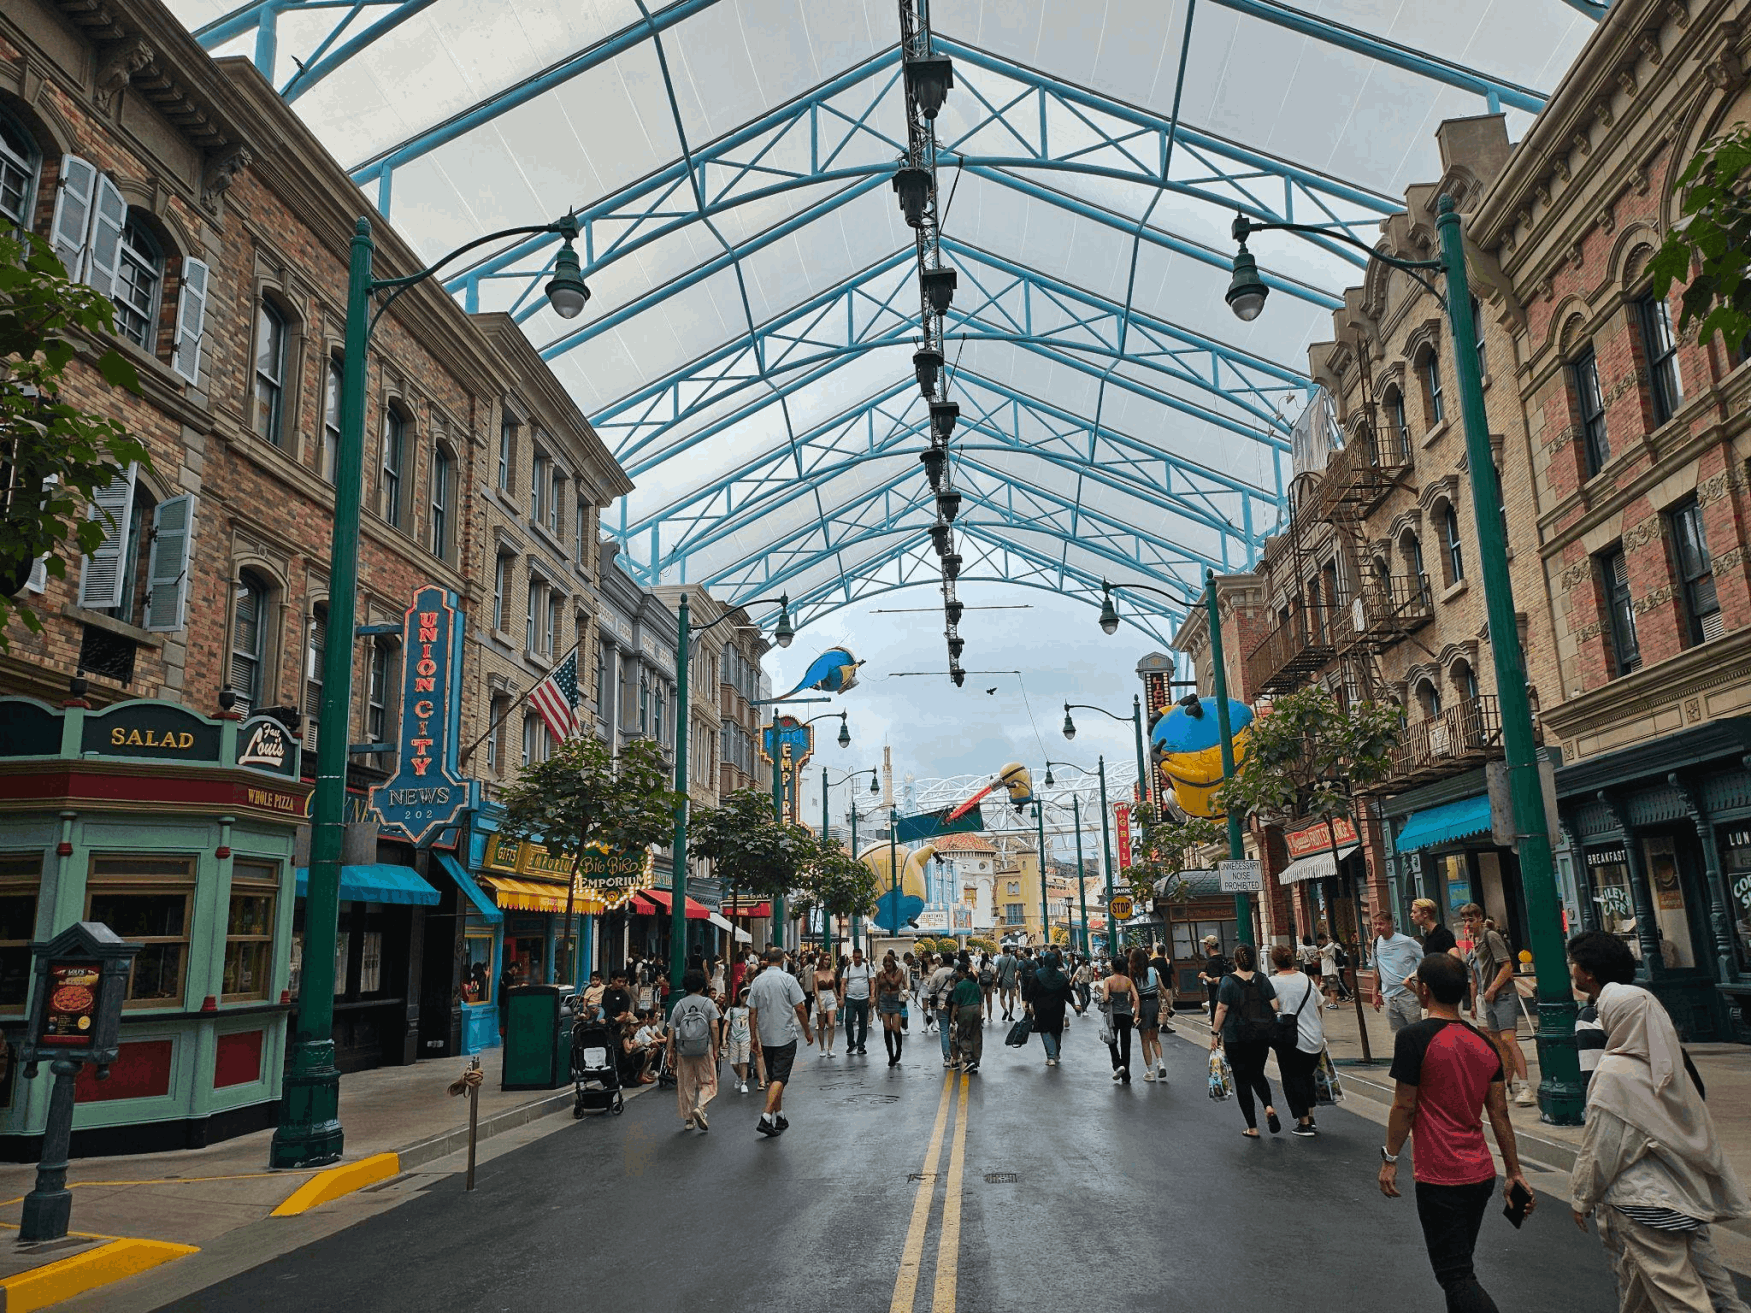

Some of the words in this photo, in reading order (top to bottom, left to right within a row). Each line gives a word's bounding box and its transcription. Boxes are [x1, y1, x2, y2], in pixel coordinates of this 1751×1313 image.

[416, 612, 438, 692] UNION
[111, 727, 194, 749] SALAD
[411, 700, 433, 776] CITY
[780, 743, 793, 829] EMPIRE
[247, 788, 273, 807] WHOLE
[274, 793, 294, 811] PIZZA
[388, 787, 450, 806] NEWS
[404, 810, 433, 819] 202
[1118, 819, 1129, 867] GRIL
[497, 846, 517, 863] GIFTS
[528, 852, 575, 874] EMPORIU
[1587, 850, 1626, 865] BREAKFAST
[1220, 861, 1260, 870] UNNECESSARY
[578, 874, 648, 889] EMPORIUM
[1233, 871, 1250, 880] NOISE
[1224, 881, 1260, 890] PROHIBITED
[1112, 902, 1130, 914] STOP
[1603, 901, 1627, 916] CAFE
